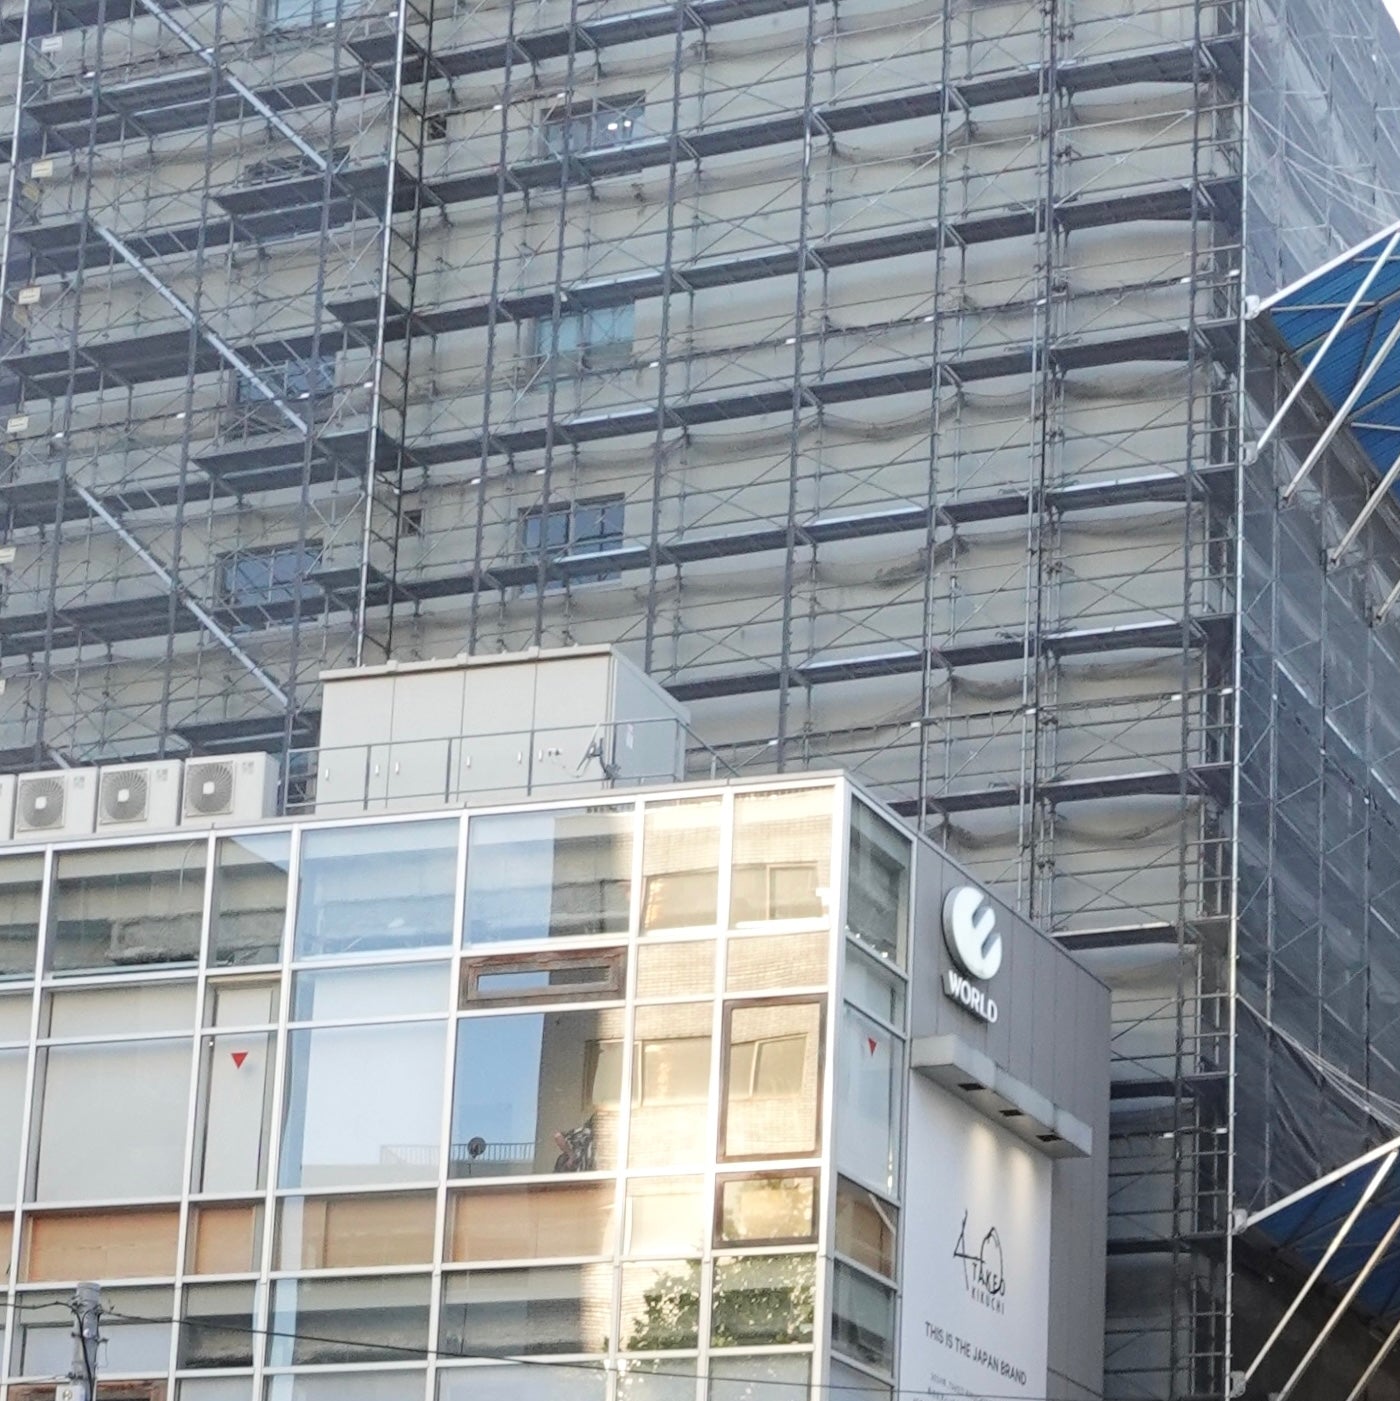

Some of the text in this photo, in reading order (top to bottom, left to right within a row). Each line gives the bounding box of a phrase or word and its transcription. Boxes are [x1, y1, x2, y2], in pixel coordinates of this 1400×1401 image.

[949, 970, 998, 1023] WORLD
[971, 1288, 1005, 1315] KIKUCHI
[972, 1262, 1006, 1297] TAKEO
[924, 1321, 1027, 1386] THIS IS THE JAPAN BRAND
